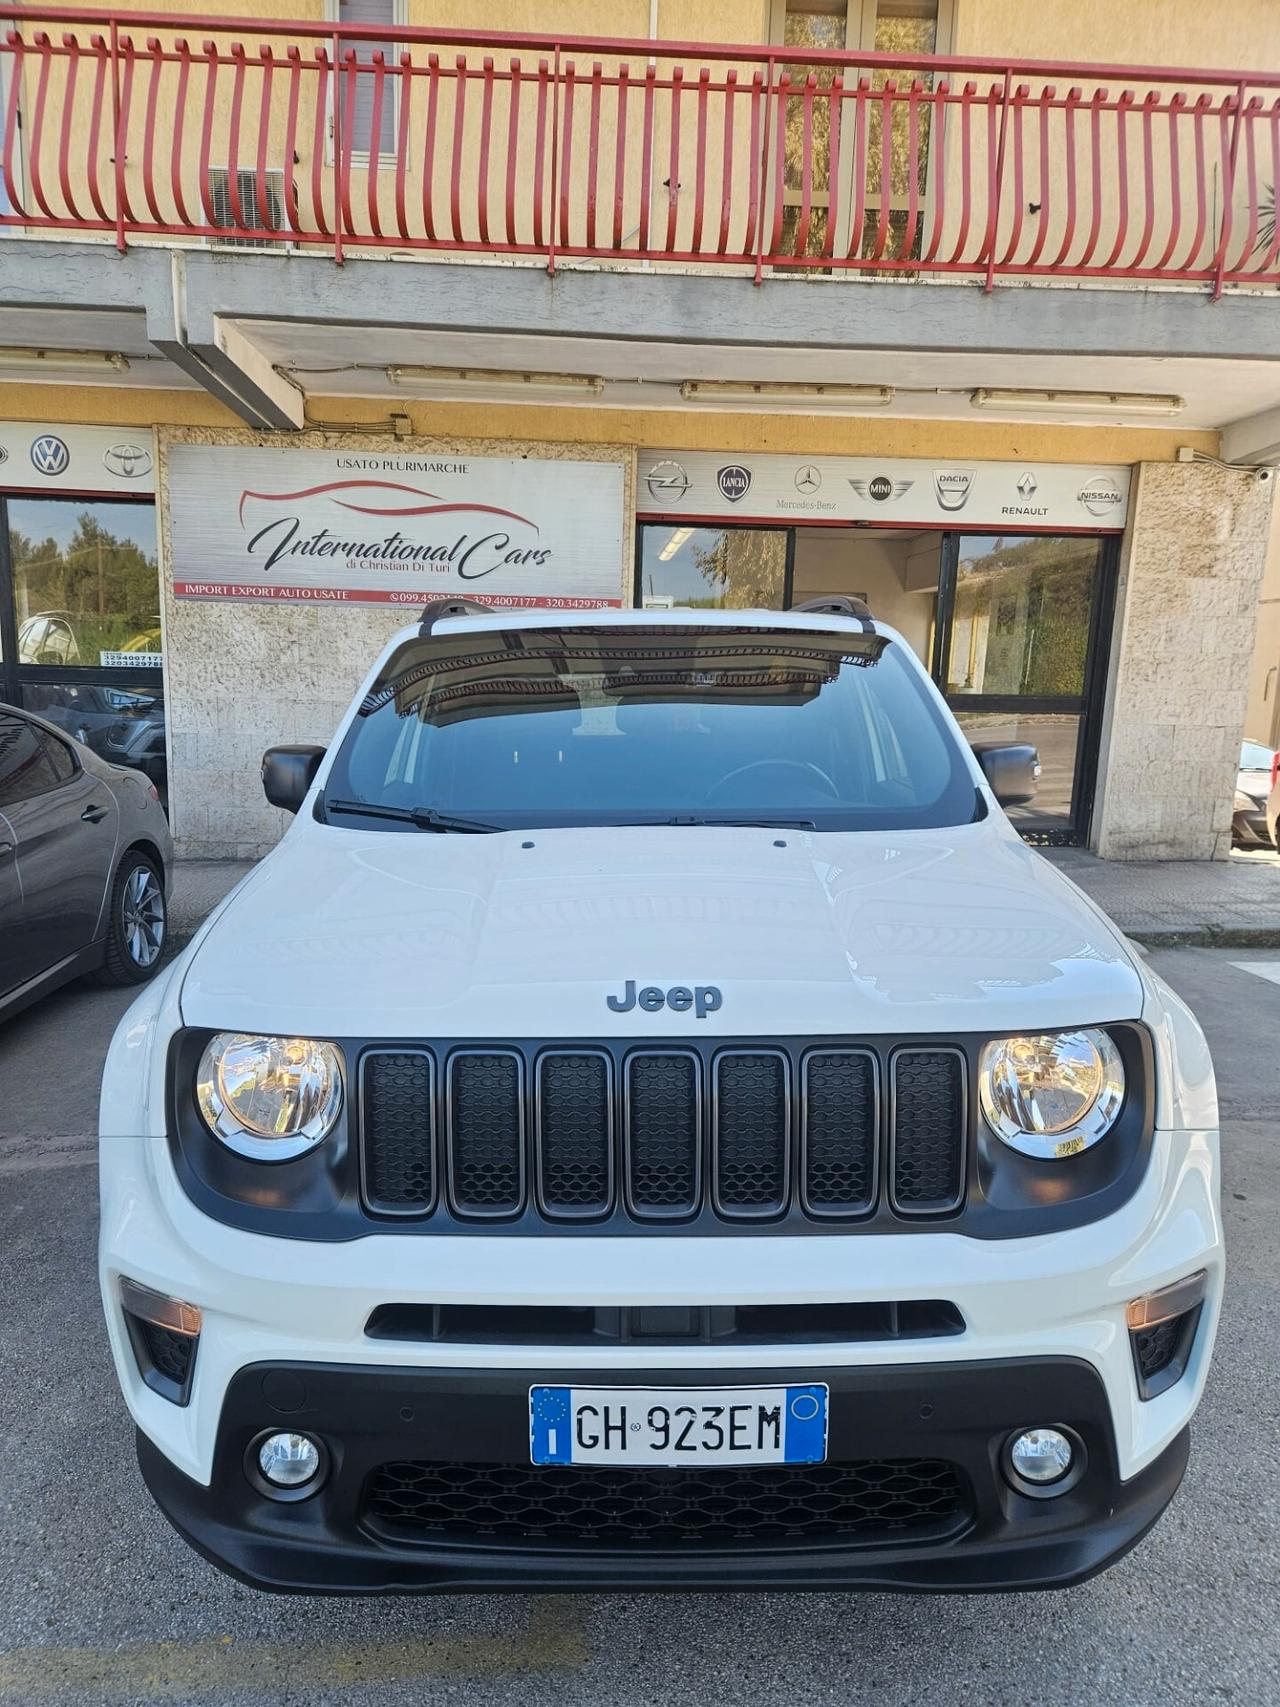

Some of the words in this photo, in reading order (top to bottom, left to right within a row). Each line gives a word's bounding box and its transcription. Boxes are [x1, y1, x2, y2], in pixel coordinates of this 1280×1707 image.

[336, 458, 379, 470] USATO
[382, 460, 470, 474] PLURIMARCHE
[722, 477, 746, 488] LANCIA
[939, 475, 968, 483] DACIA
[870, 483, 891, 494] MINI
[1081, 491, 1119, 500] NISSAN
[776, 499, 837, 511] Mercedes-Benz
[1001, 506, 1049, 516] RENAULT
[247, 517, 467, 571] International
[457, 533, 553, 580] Cars
[346, 558, 356, 569] di
[360, 560, 409, 571] Christian
[412, 561, 424, 572] Di
[428, 563, 450, 573] Turi
[185, 584, 227, 595] IMPORT
[232, 586, 276, 597] EXPORT
[279, 589, 311, 599] AUTO
[313, 590, 349, 600] USATE
[545, 598, 608, 609] 320.3429788
[606, 980, 723, 1019] Jeep
[576, 1405, 627, 1450] GH
[647, 1405, 781, 1451] 923EM
